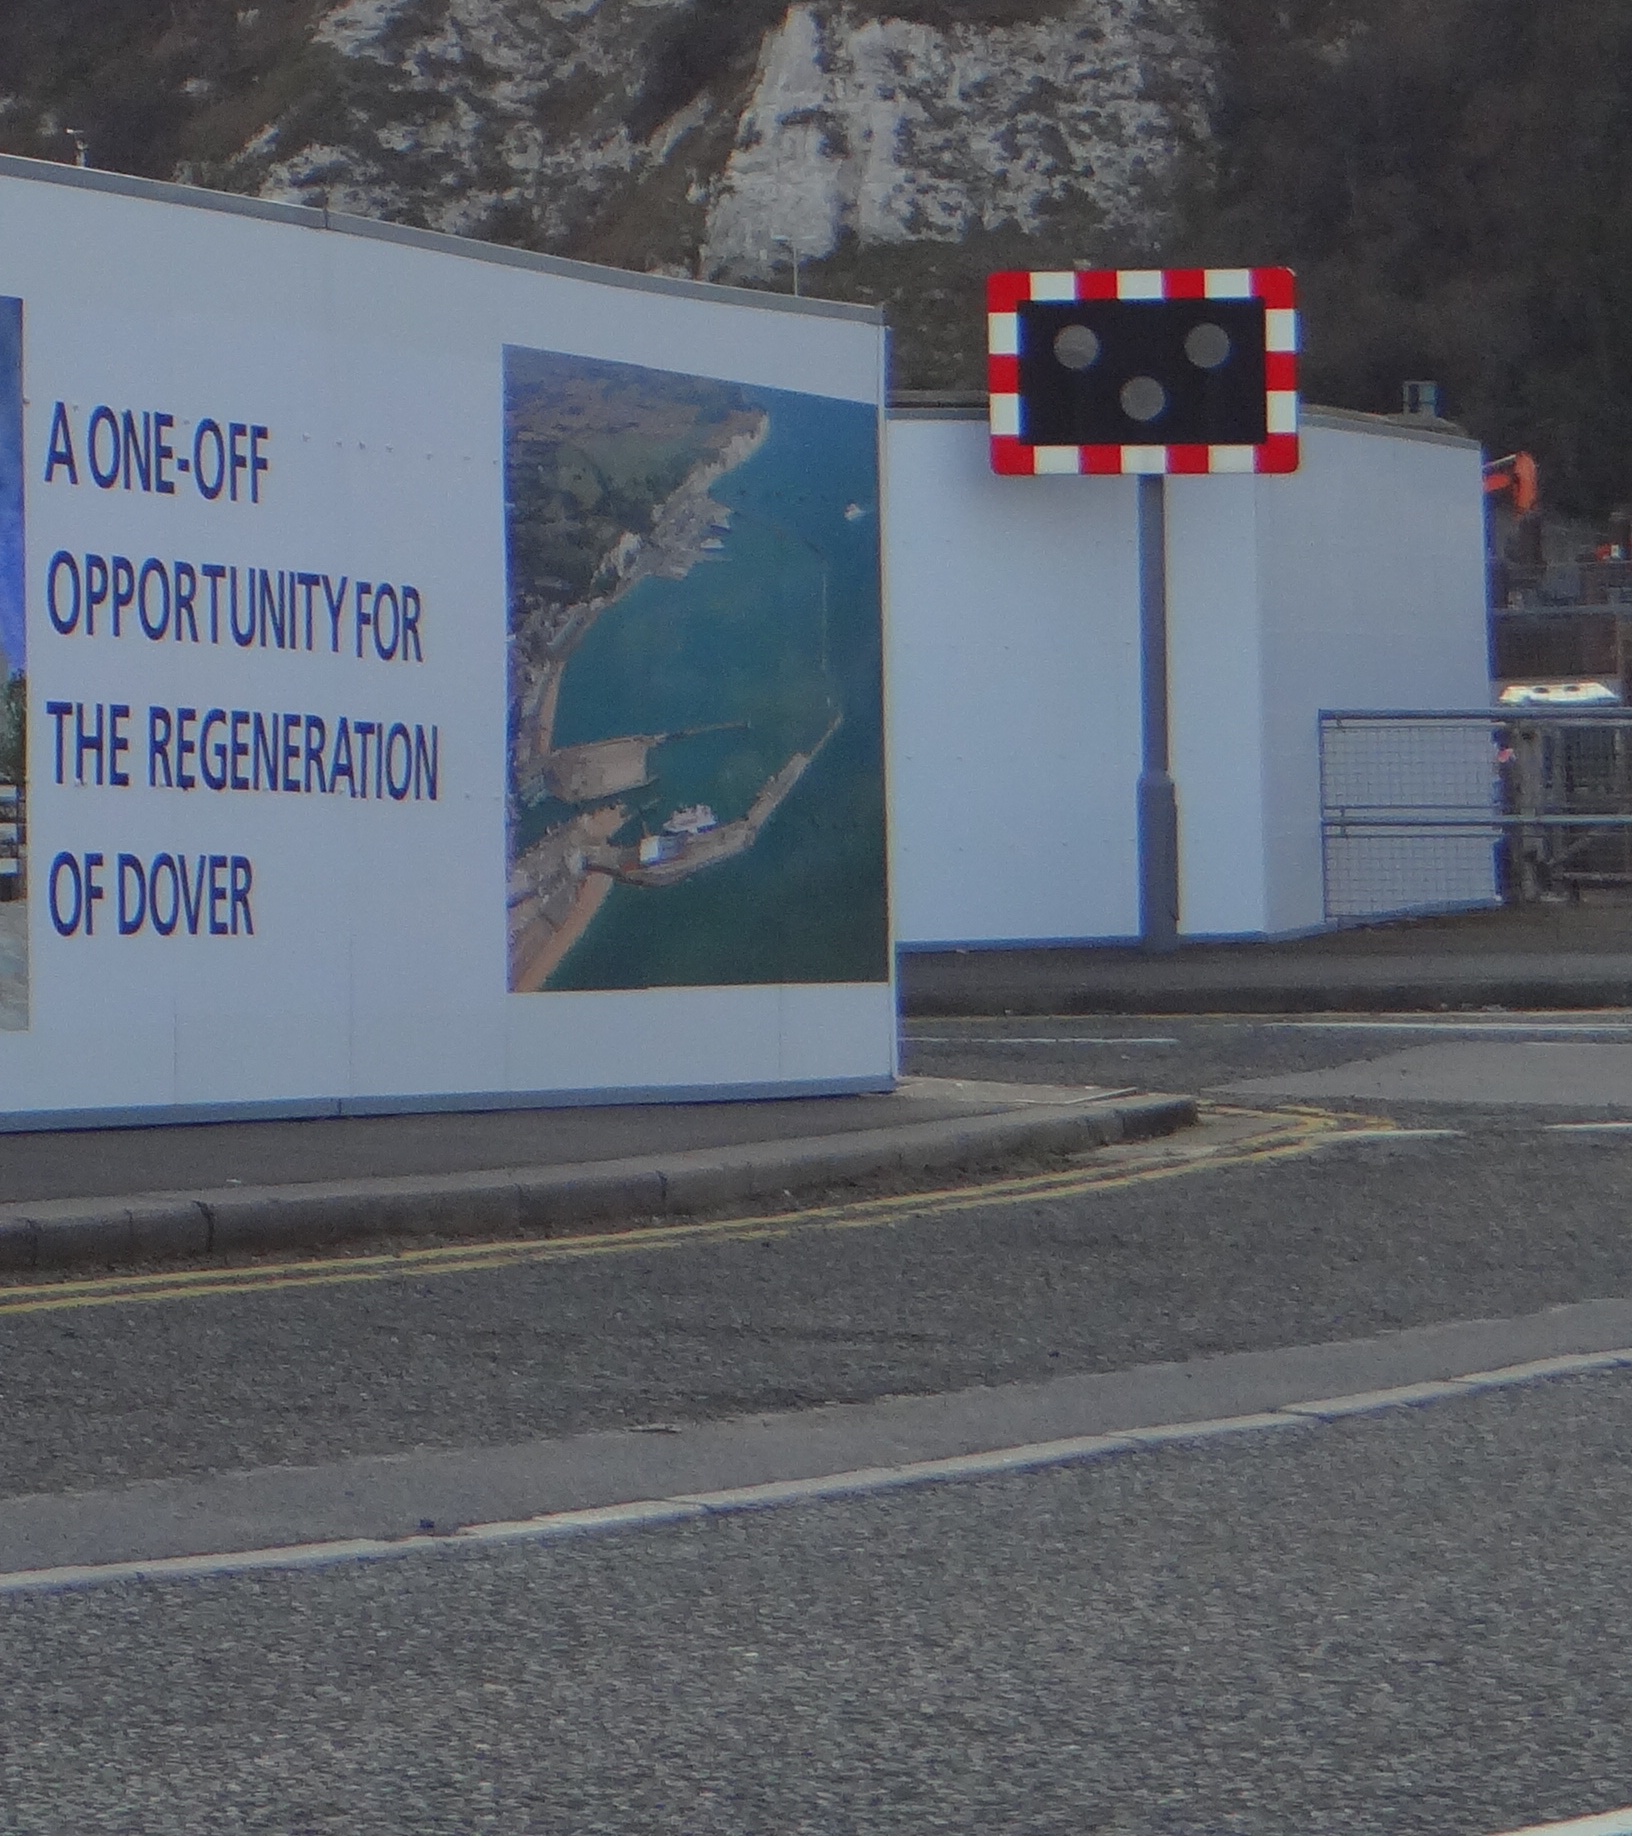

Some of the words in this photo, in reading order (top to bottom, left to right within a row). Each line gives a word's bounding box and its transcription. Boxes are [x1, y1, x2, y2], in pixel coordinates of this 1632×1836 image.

[44, 400, 77, 485] A
[87, 404, 269, 504] ONE-OFF
[47, 550, 347, 653] OPPORTUNITY
[355, 580, 423, 662] FOR
[46, 700, 130, 786] THE
[149, 705, 438, 801] REGENERATION
[49, 851, 103, 936] OF
[117, 851, 254, 936] DOVER
